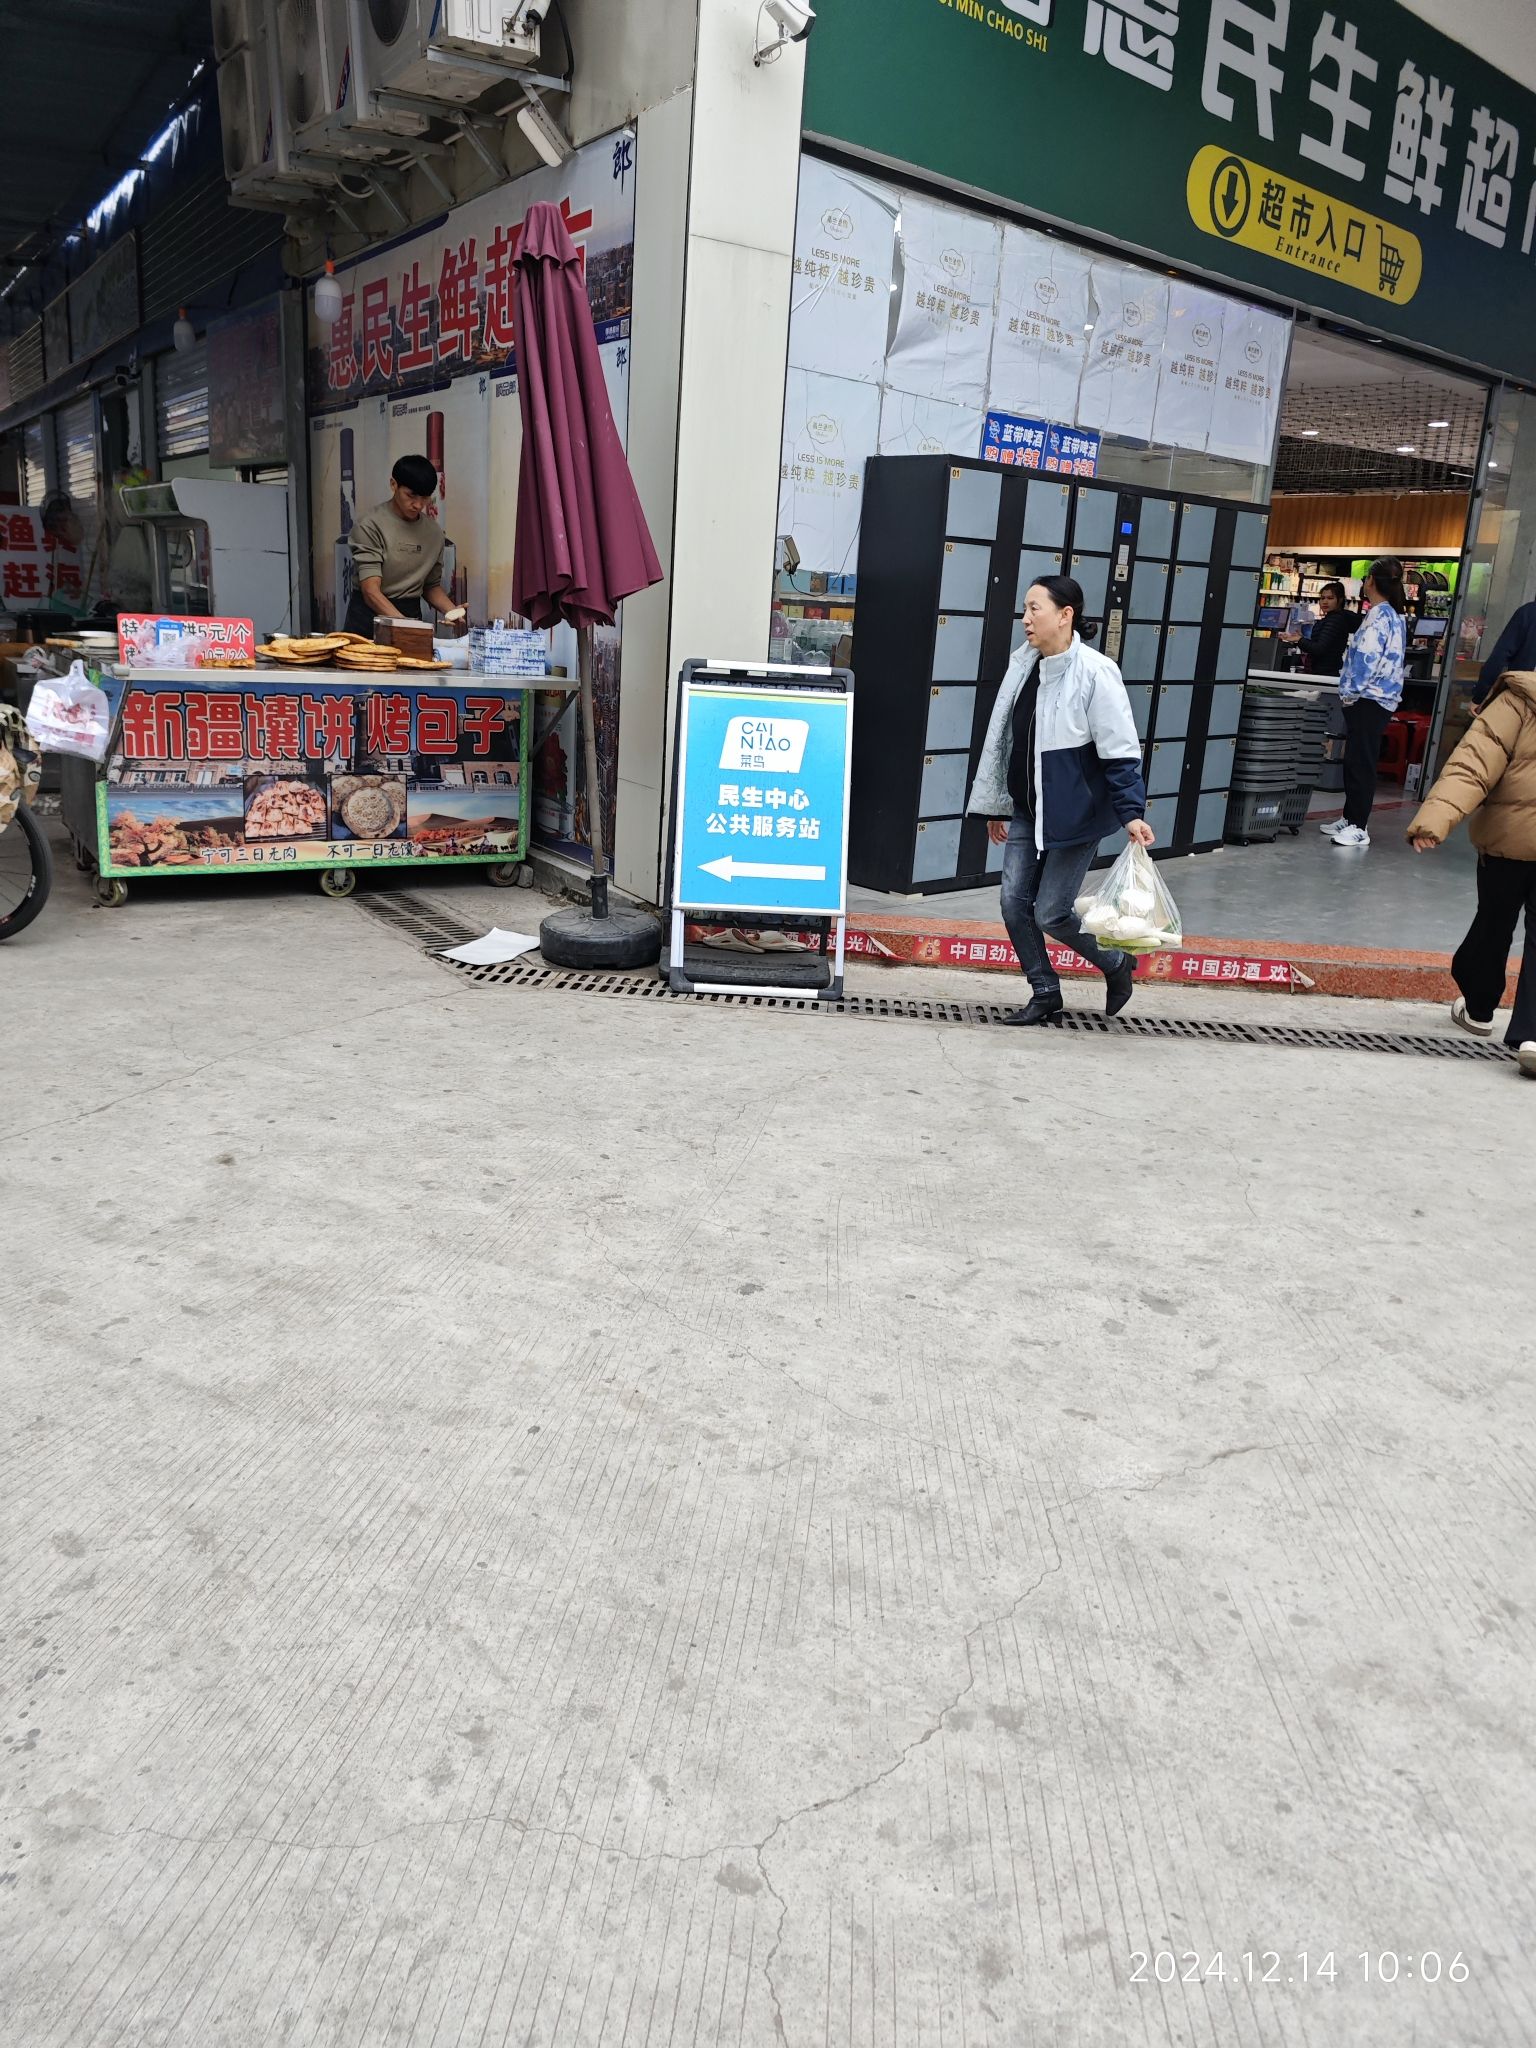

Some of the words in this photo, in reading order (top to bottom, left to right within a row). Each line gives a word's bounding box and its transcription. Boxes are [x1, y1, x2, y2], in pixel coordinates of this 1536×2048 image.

[986, 9, 1024, 41] CHAO
[1025, 28, 1048, 53] SHI
[1257, 177, 1367, 263] 超市入口
[811, 247, 829, 260] LESS
[839, 255, 861, 269] MORE
[1275, 235, 1342, 274] Entrance
[837, 268, 875, 294] 越珍贵
[933, 283, 948, 295] LESS
[952, 290, 971, 303] MORE
[1001, 423, 1045, 449] 蓝带啤酒
[1060, 435, 1098, 460] 蓝带啤酒
[797, 452, 815, 464] LESS
[824, 457, 845, 468] MORE
[822, 471, 860, 491] 越珍贵
[952, 469, 960, 478] 01
[939, 617, 947, 625] 03
[932, 688, 939, 696] 04
[122, 691, 356, 760] 新疆馕饼
[367, 692, 505, 756] 烤包子
[741, 721, 774, 736] CAI
[741, 732, 791, 752] NIAO
[740, 754, 765, 769] 菜鸟
[924, 757, 933, 765] 05
[717, 784, 811, 811] 民生中心
[705, 812, 821, 840] 公共服务站
[918, 823, 926, 831] 06
[201, 846, 298, 865] 宁可三日无肉
[1181, 957, 1262, 980] 中国劲酒
